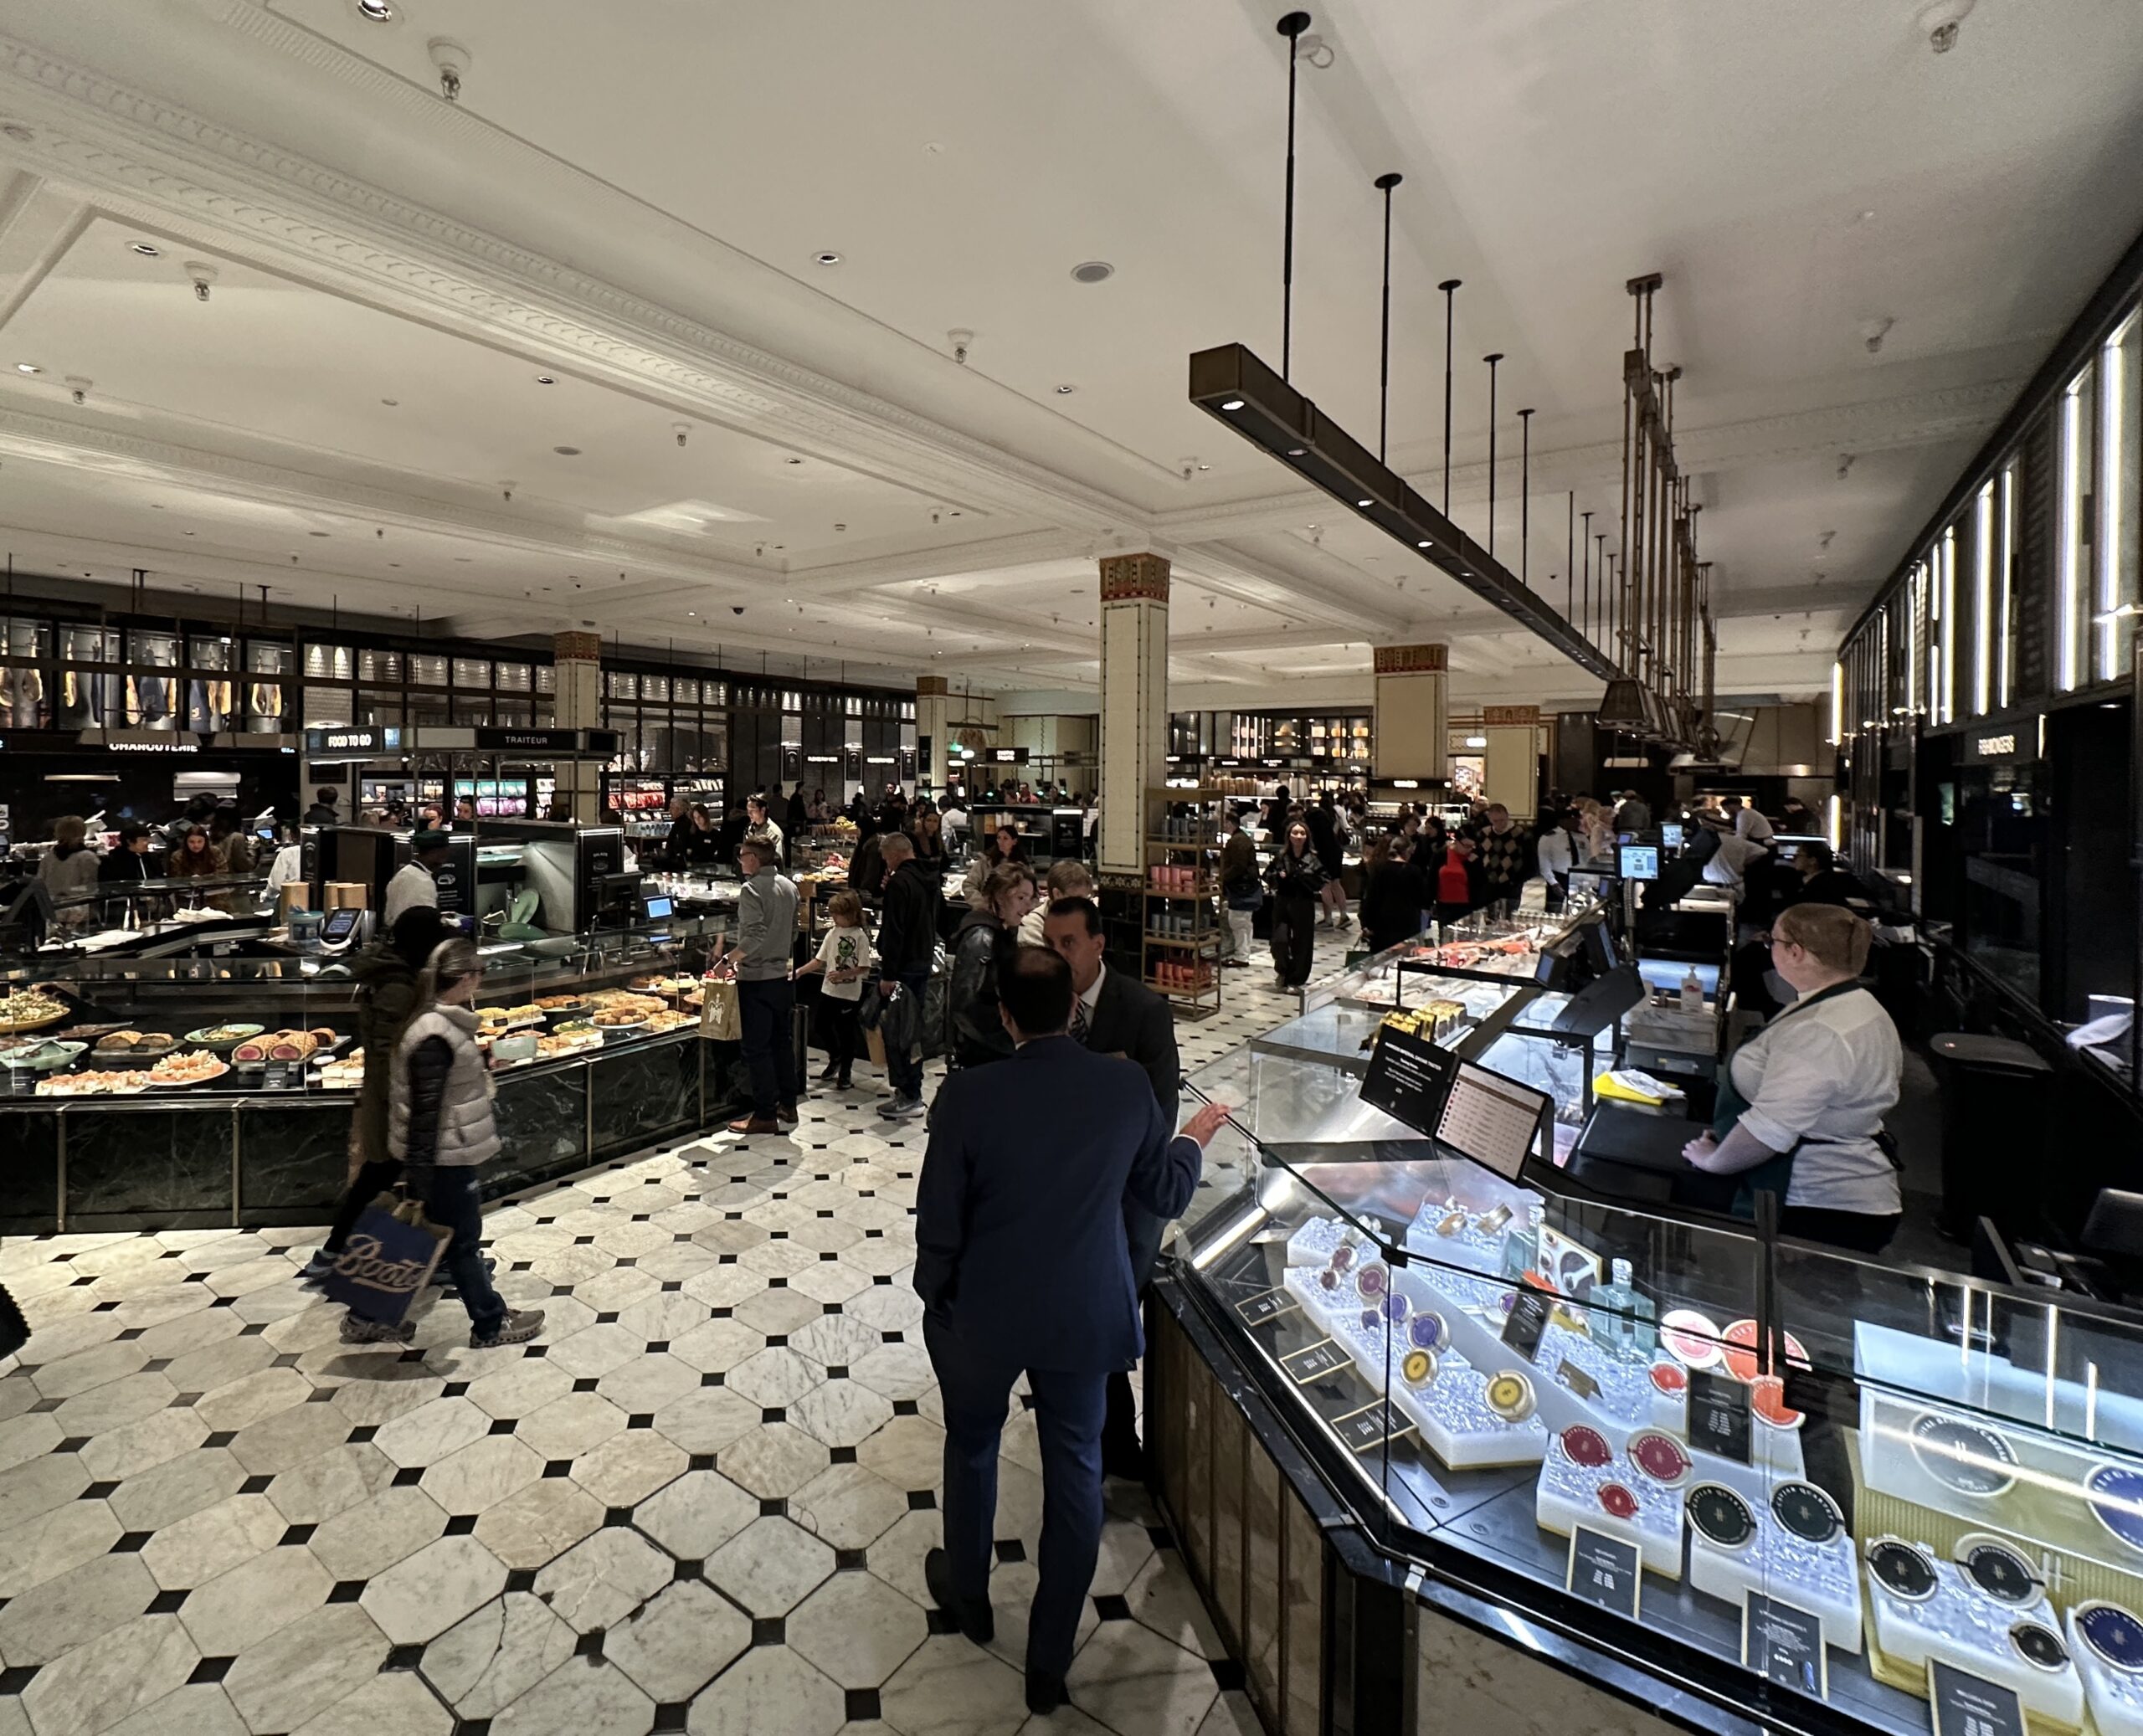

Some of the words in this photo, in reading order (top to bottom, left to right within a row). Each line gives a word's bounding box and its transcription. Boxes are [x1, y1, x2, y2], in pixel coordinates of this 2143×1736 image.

[328, 735, 347, 747] FOOD
[347, 734, 359, 747] TO
[359, 733, 372, 747] GO
[505, 735, 547, 745] TRAITEUR
